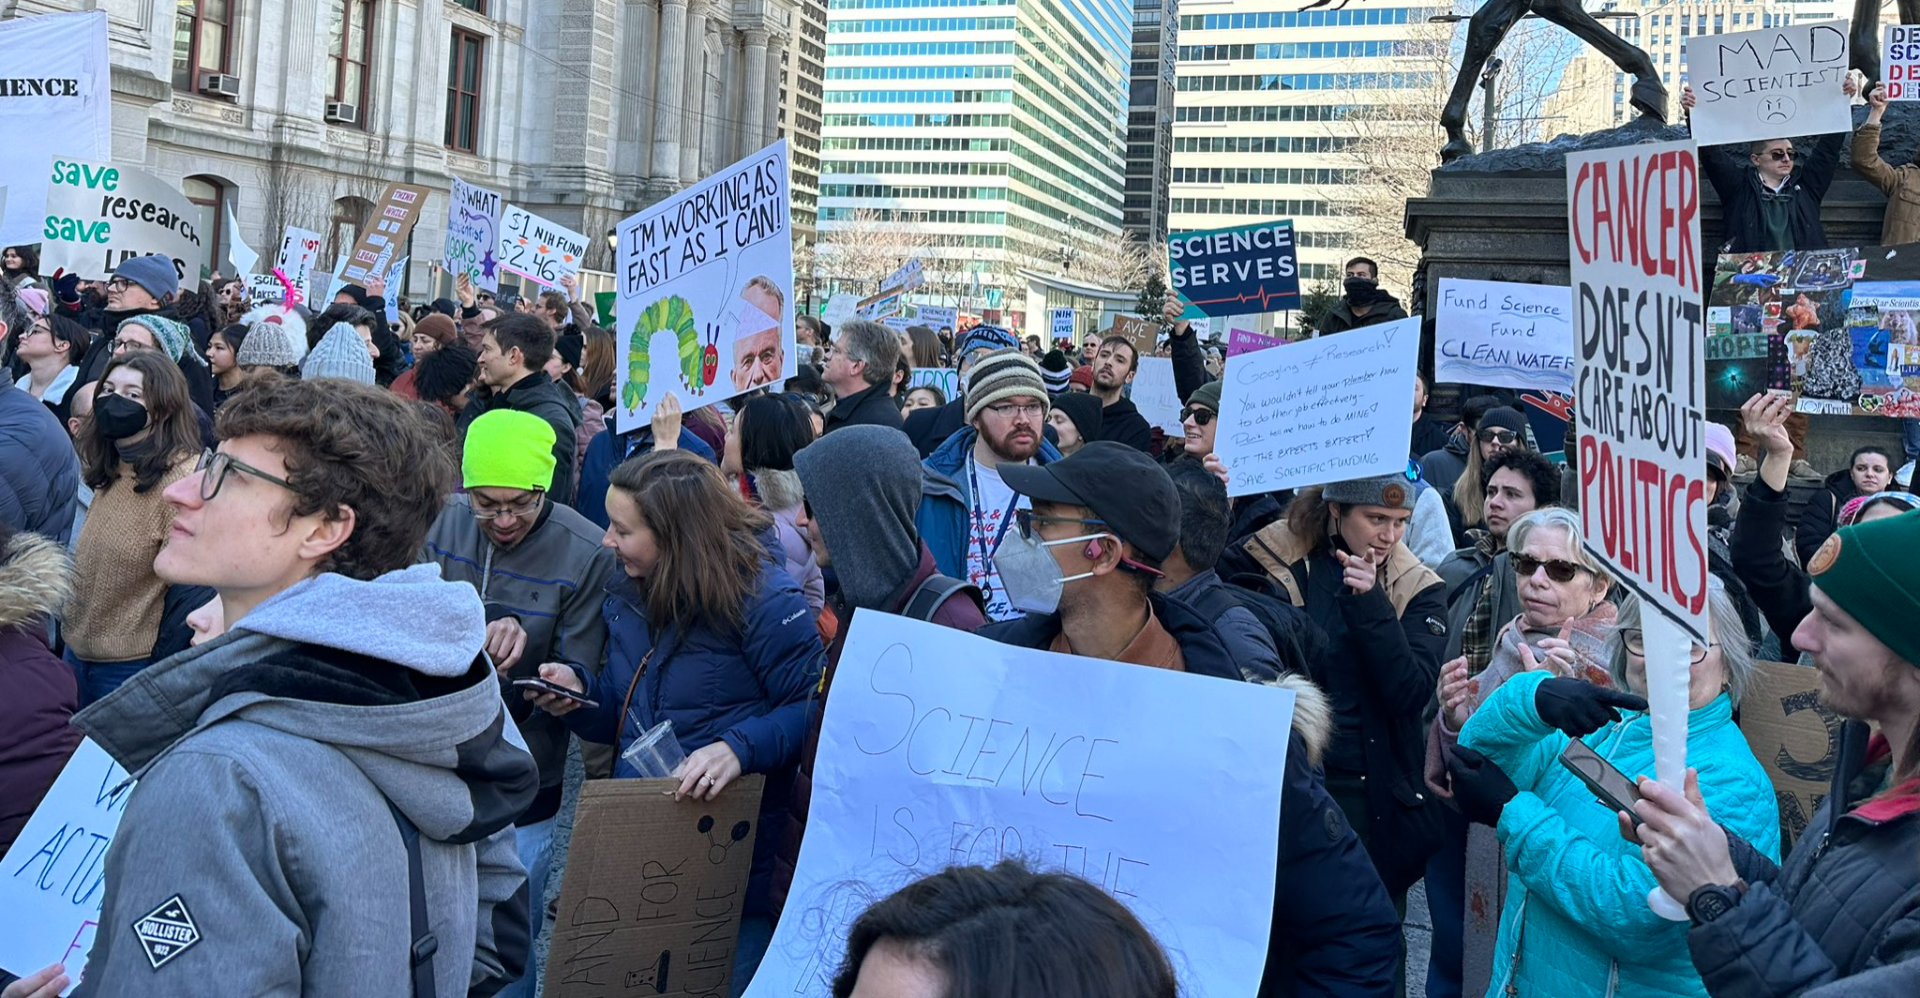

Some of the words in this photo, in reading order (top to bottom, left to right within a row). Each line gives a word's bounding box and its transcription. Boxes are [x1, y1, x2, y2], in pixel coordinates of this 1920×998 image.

[1719, 25, 1845, 76] MAD
[1703, 66, 1846, 103] SCIENTIST
[52, 160, 119, 191] save
[466, 186, 498, 218] WHAT
[630, 218, 656, 257] I'M
[661, 172, 750, 237] WORKING
[754, 159, 778, 202] AS
[44, 216, 111, 244] save
[101, 195, 200, 247] research
[508, 210, 530, 239] $1
[534, 226, 555, 246] NIH
[556, 237, 583, 257] FUND
[1572, 150, 1699, 293] CANCER
[301, 238, 319, 253] NOT
[628, 246, 671, 294] FAST
[679, 231, 707, 274] AS
[714, 220, 729, 258] I
[735, 197, 781, 246] CAN!
[1169, 225, 1292, 259] SCIENCE
[1171, 255, 1295, 288] SERVES
[1055, 310, 1072, 319] NIH
[1444, 289, 1488, 310] Fund
[1501, 295, 1562, 315] Science
[1054, 325, 1073, 333] LIVES
[1116, 318, 1149, 338] SAVE
[1491, 321, 1537, 337] Fund
[1579, 280, 1702, 407] DOESN'T
[1442, 339, 1510, 364] CLEAN
[1706, 336, 1768, 358] HOPE
[1236, 360, 1299, 386] Googling
[1239, 393, 1256, 415] You
[1261, 389, 1302, 407] wouldn't
[1305, 385, 1318, 397] tell
[1321, 380, 1340, 398] your
[1579, 365, 1626, 445] CARE
[1630, 383, 1703, 460] ABOUT
[1238, 418, 1252, 428] to
[1255, 413, 1269, 424] do
[1272, 407, 1293, 420] their
[1294, 404, 1309, 418] job
[1283, 426, 1294, 435] me
[1298, 422, 1316, 431] how
[1318, 418, 1327, 427] to
[1331, 415, 1341, 424] do
[1253, 449, 1273, 463] THE
[1278, 442, 1318, 458] EXPERTS
[1329, 452, 1379, 469] FUNDING
[1580, 435, 1706, 615] POLITICS
[854, 642, 1119, 822] SCIENCE
[870, 804, 921, 867] IS
[636, 857, 688, 921] FOR
[141, 921, 192, 942] HOLLISTER
